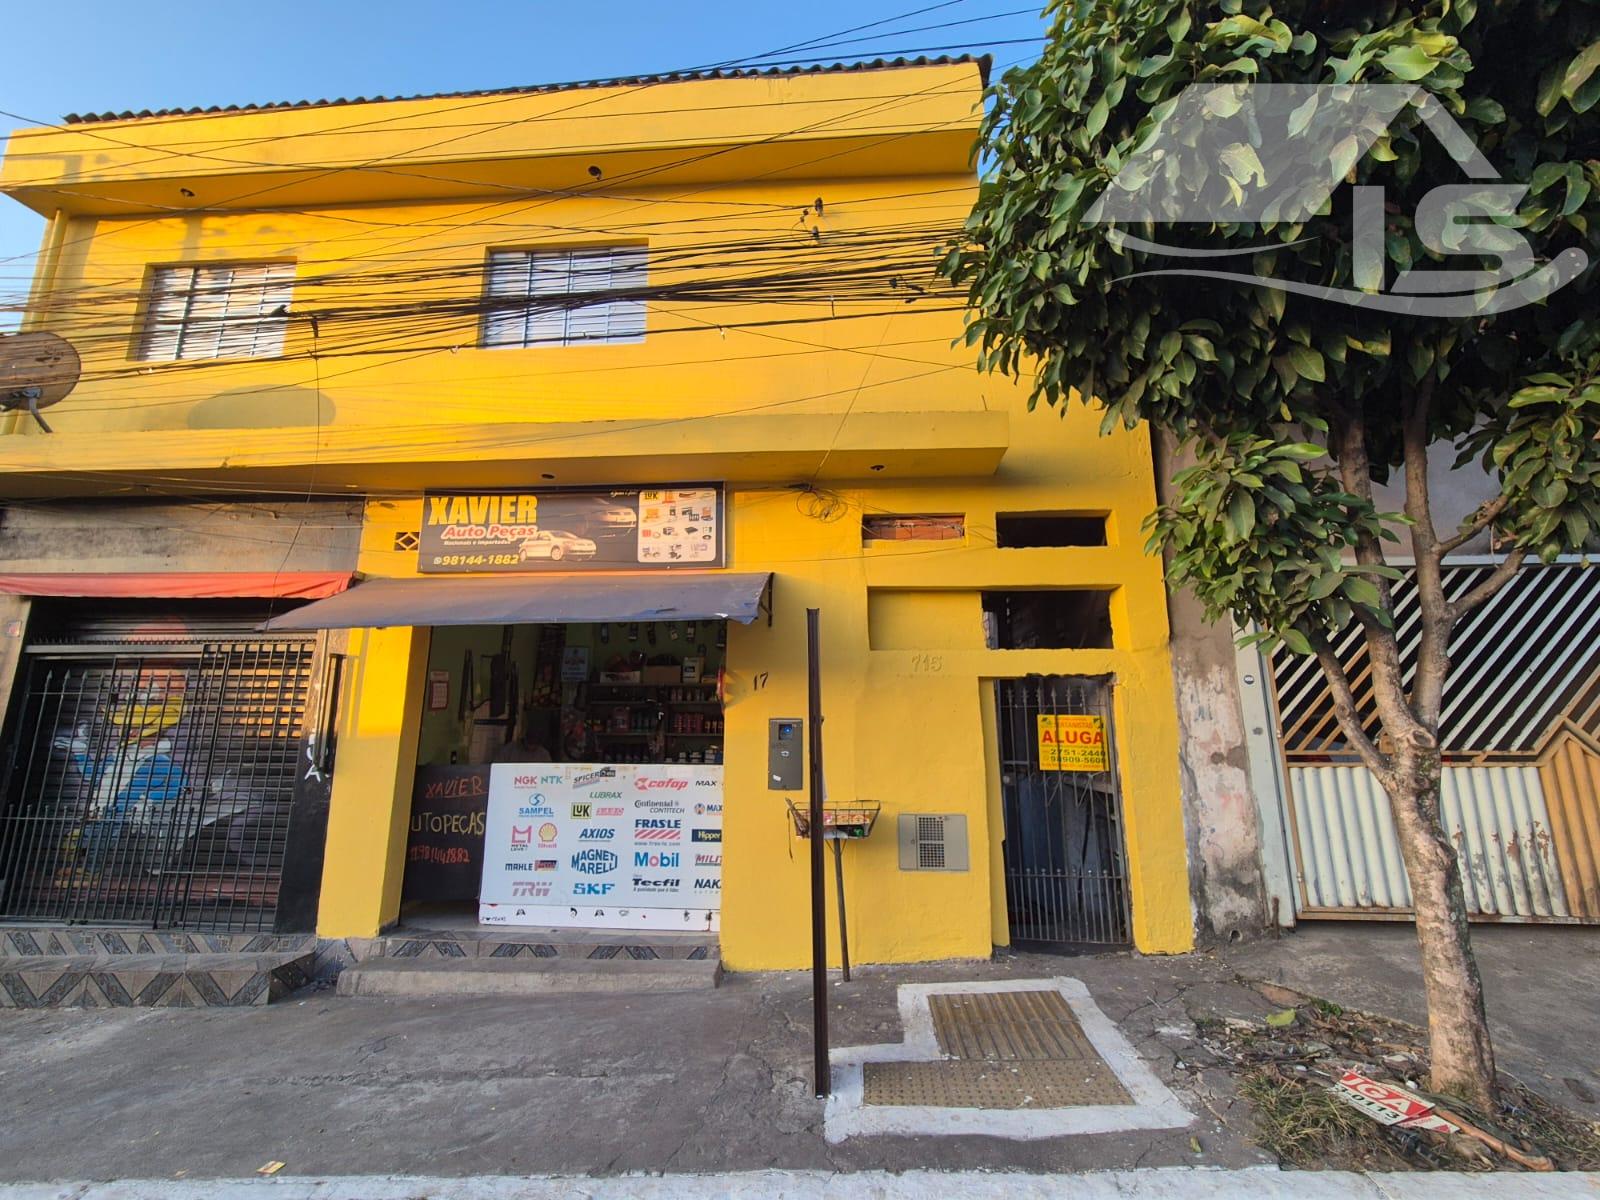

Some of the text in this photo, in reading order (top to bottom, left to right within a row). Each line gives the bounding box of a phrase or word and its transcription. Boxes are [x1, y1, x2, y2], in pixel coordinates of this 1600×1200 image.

[428, 495, 538, 525] XAVIER
[442, 524, 538, 541] Auto Peças
[442, 554, 519, 566] 98144-1882
[752, 671, 769, 691] 17
[1042, 730, 1104, 744] ALUGA
[514, 776, 564, 785] NGK NTK
[573, 771, 600, 784] SPICER
[648, 777, 688, 790] cofap
[589, 791, 623, 799] LUBRAX
[634, 800, 673, 809] Continental
[519, 807, 554, 815] SAMPEL
[578, 828, 615, 839] AXIOS
[634, 851, 679, 868] Mobil
[505, 863, 533, 871] MAHLE
[573, 882, 615, 895] SKF
[632, 878, 680, 887] Tecfil
[694, 878, 722, 889] NAK
